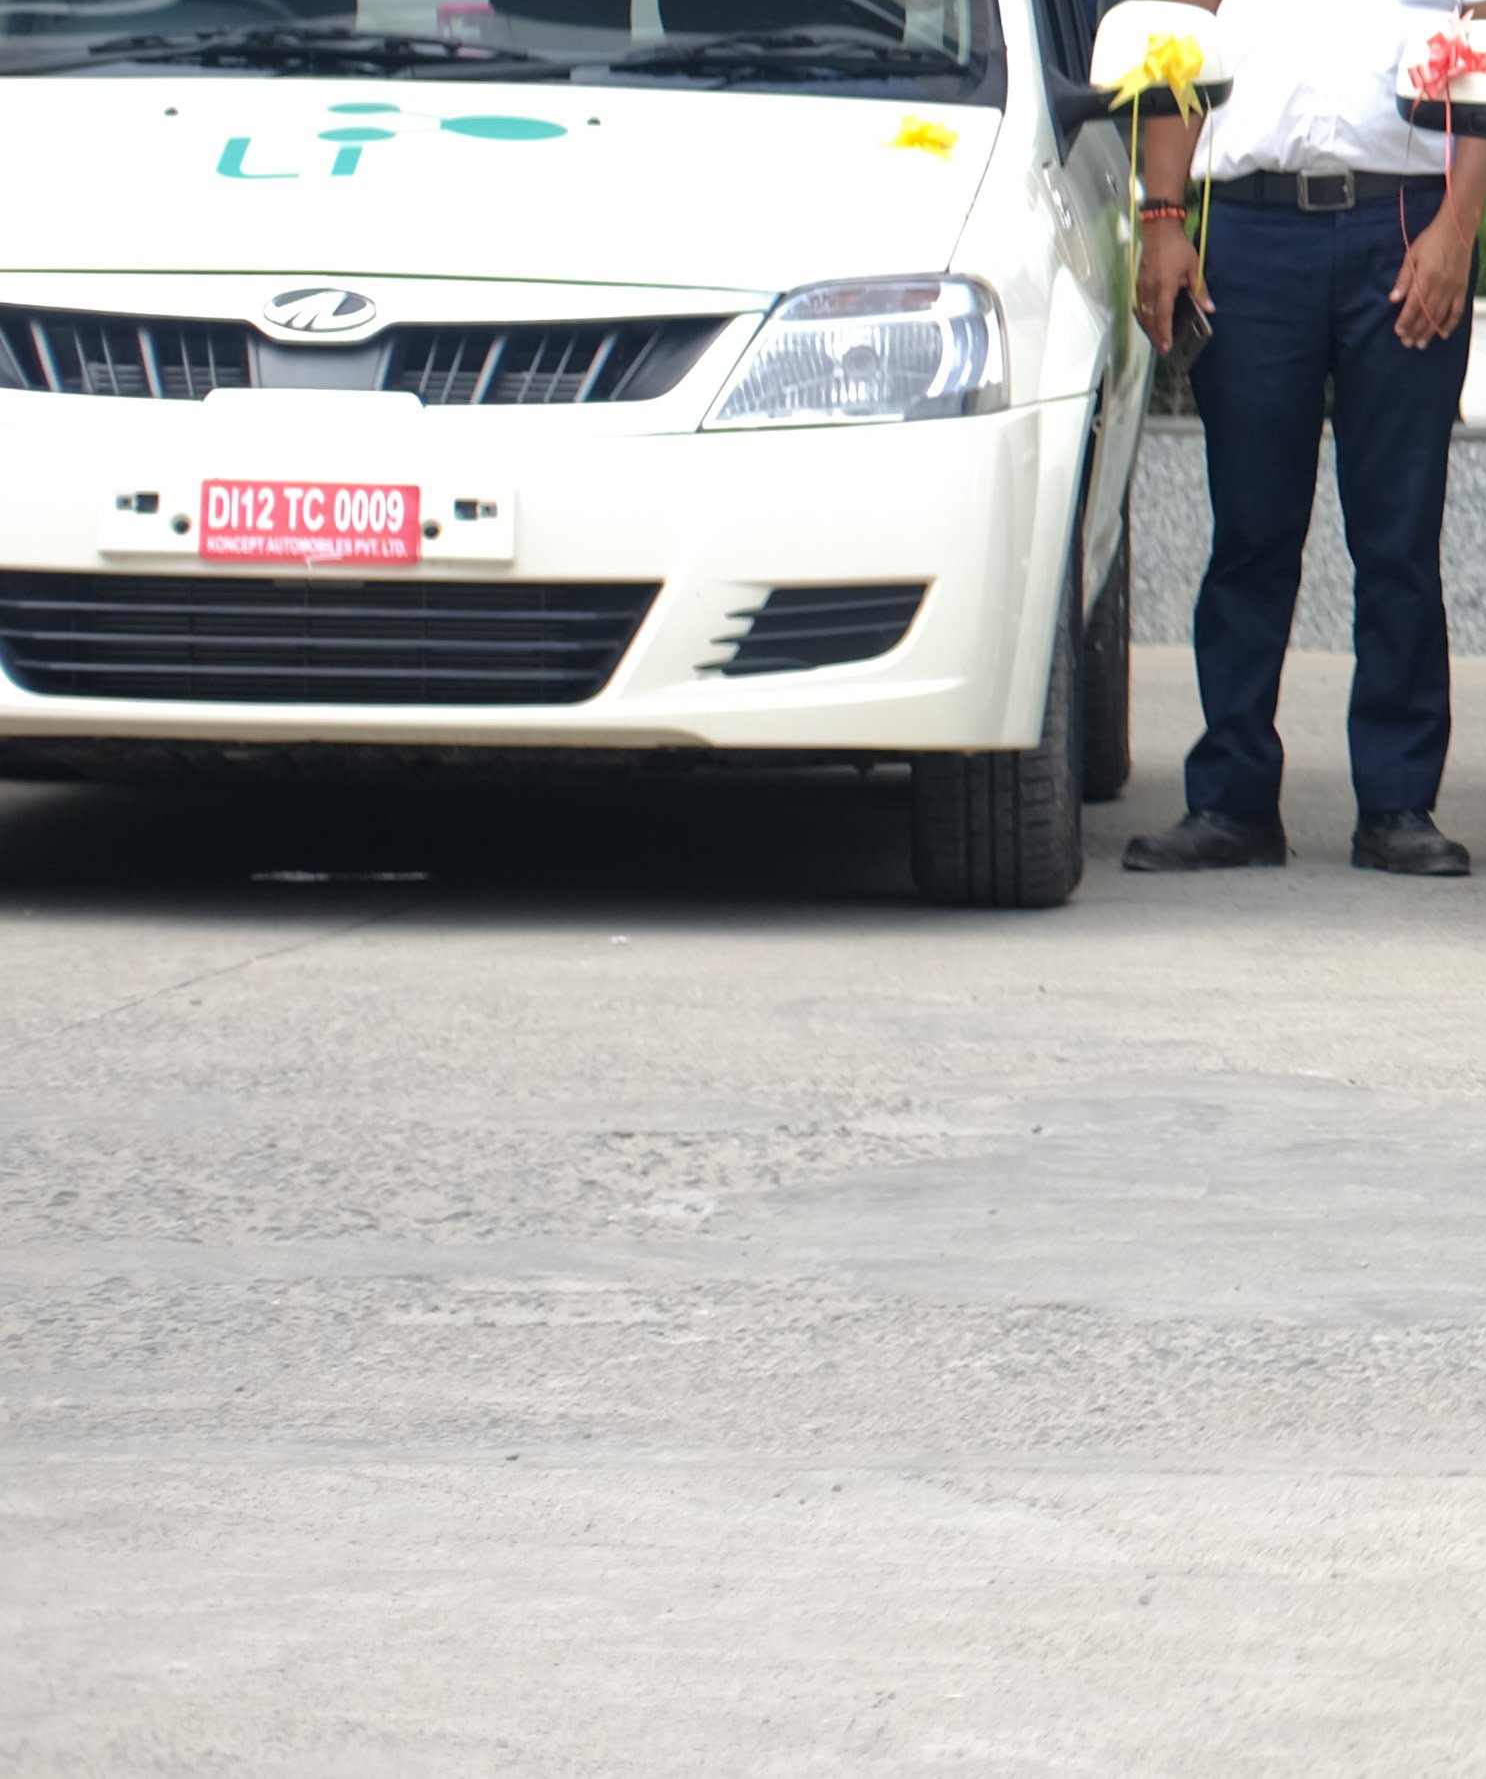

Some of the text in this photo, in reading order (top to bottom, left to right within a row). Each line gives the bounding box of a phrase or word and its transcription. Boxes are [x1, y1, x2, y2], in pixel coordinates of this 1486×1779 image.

[283, 488, 325, 533] TC
[334, 488, 405, 534] 0009
[206, 535, 265, 553] KONCEPT
[266, 536, 353, 557] AUTOMOBILES
